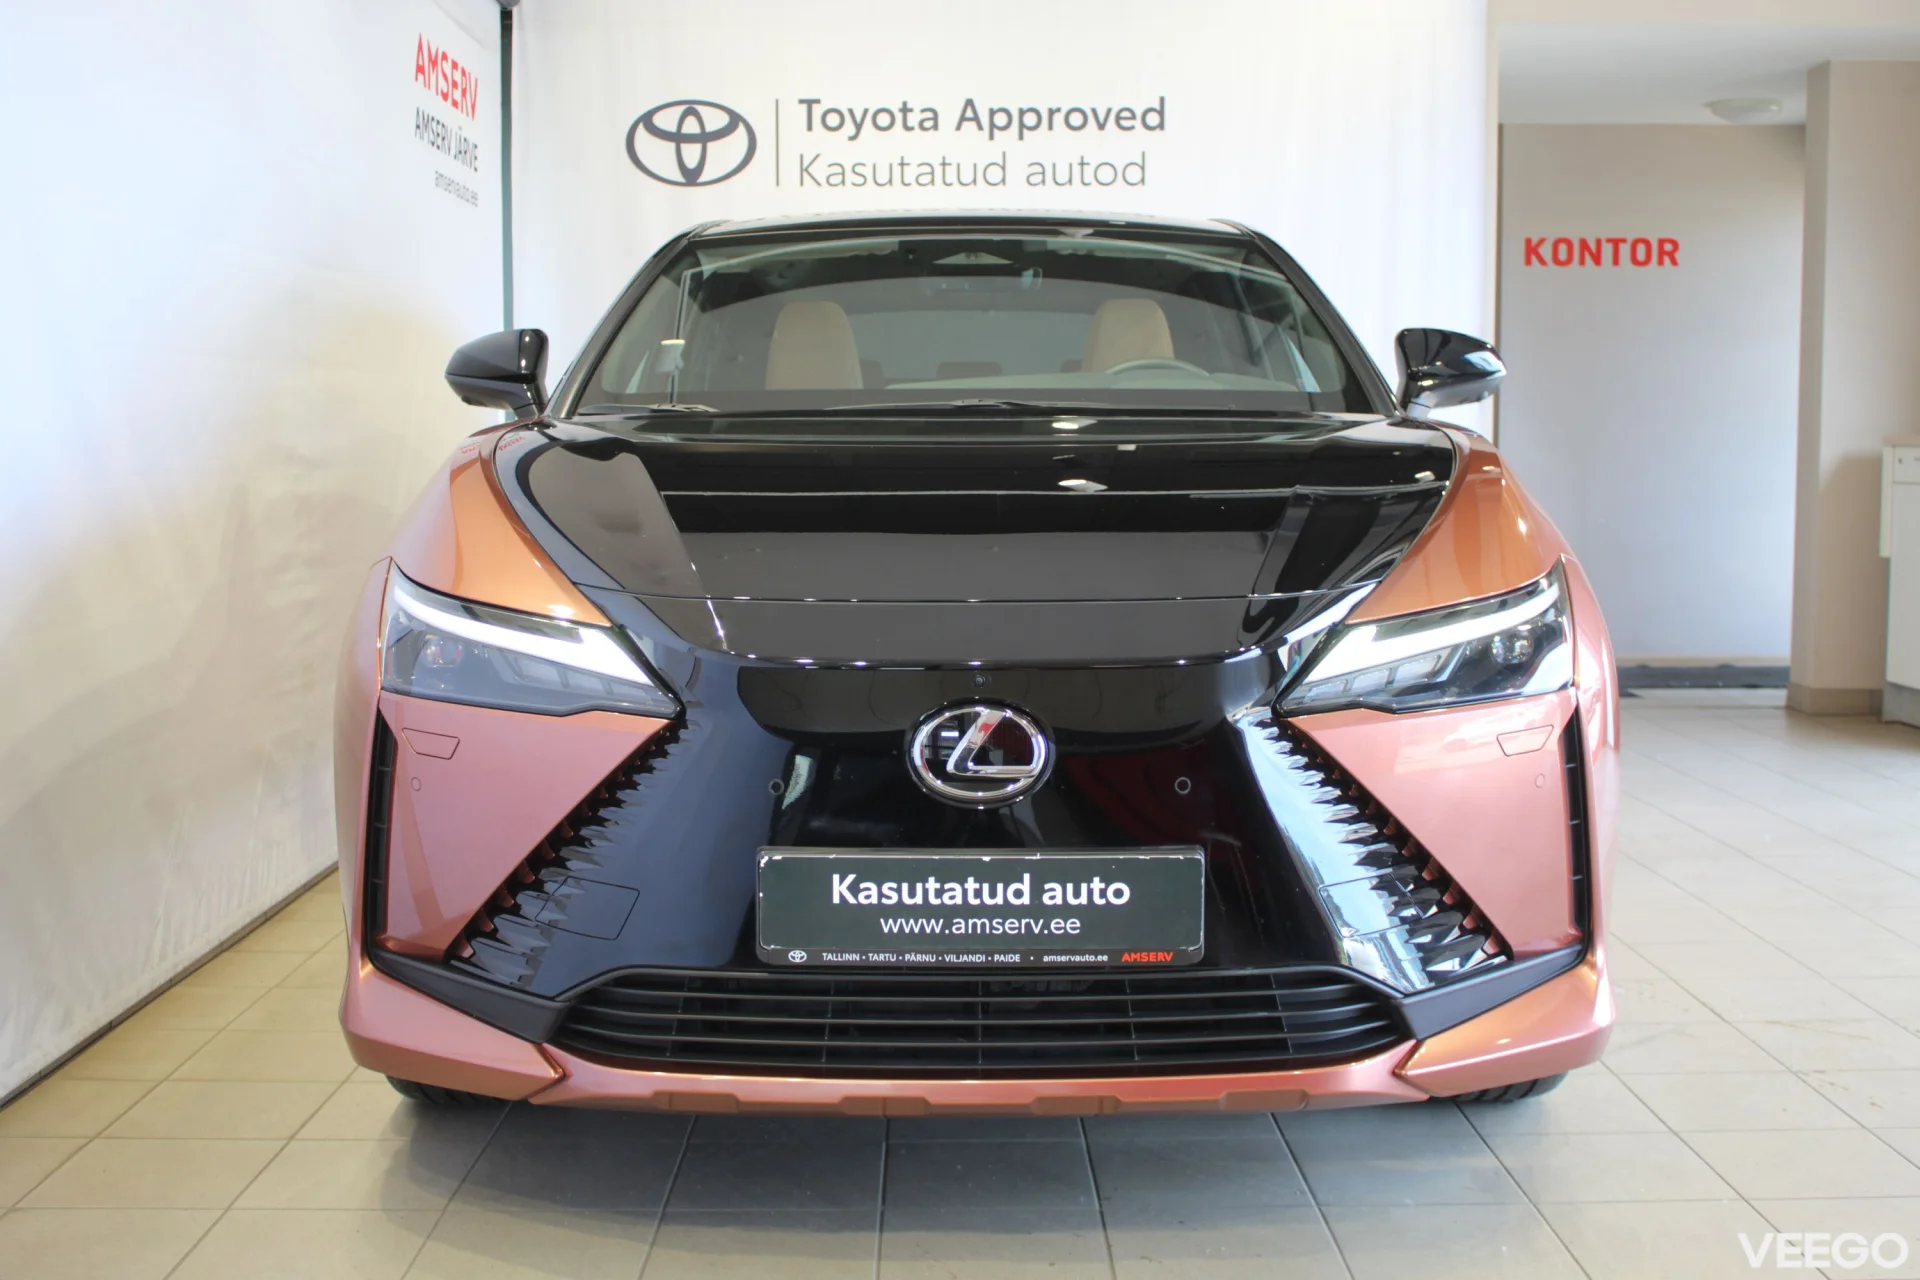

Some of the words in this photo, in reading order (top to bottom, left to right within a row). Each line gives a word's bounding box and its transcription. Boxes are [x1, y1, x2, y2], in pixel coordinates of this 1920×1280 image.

[415, 32, 479, 121] AMSERV
[798, 98, 940, 141] Toyota
[954, 96, 1166, 141] Approved
[415, 106, 453, 156] AMSERV
[453, 125, 478, 173] JÄRVE
[799, 151, 1007, 187] Kasutatud
[1025, 151, 1147, 187] autod
[1523, 236, 1681, 268] KONTOR
[831, 873, 1031, 906] Kasutatud
[1041, 875, 1131, 906] auto
[879, 915, 1082, 936] www.amserv.ee
[821, 952, 860, 962] TALLINN
[867, 953, 897, 962] TARTU
[904, 951, 936, 963] PÄRNU
[943, 954, 986, 963] VILJANDI
[993, 954, 1021, 963] PAIDE
[1042, 953, 1109, 963] amservauto.ee
[1120, 951, 1175, 964] AMSERV
